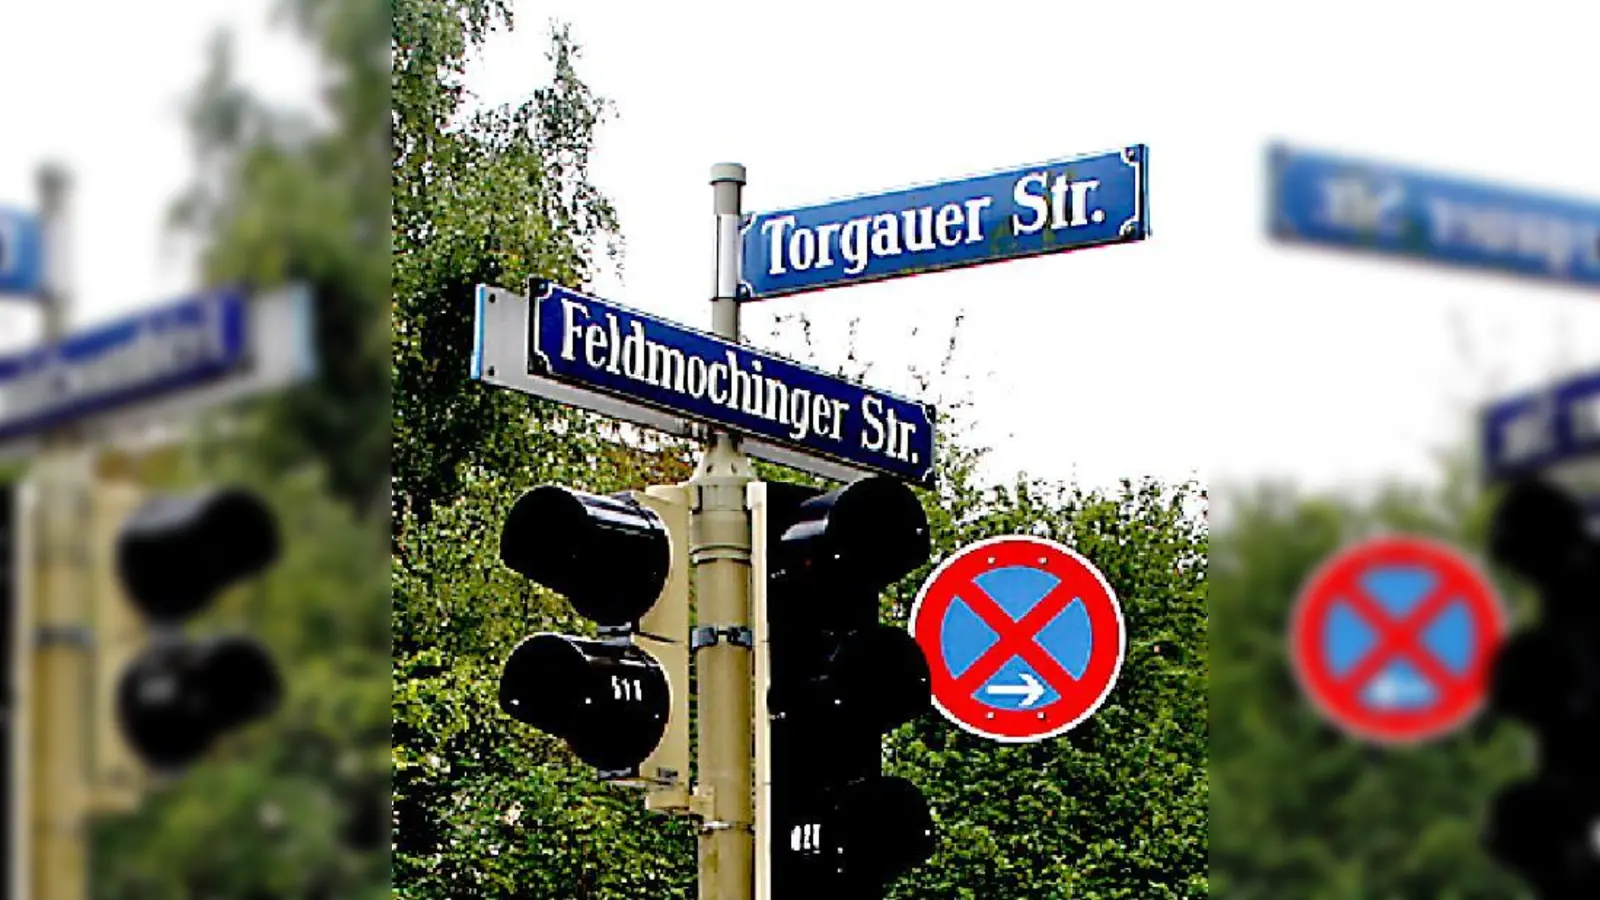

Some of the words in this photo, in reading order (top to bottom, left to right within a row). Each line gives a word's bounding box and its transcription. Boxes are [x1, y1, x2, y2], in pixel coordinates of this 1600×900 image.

[763, 196, 991, 274] Torgauer
[1013, 172, 1105, 236] Str.
[560, 298, 849, 441] Feldmochinger
[861, 398, 919, 464] Str.
